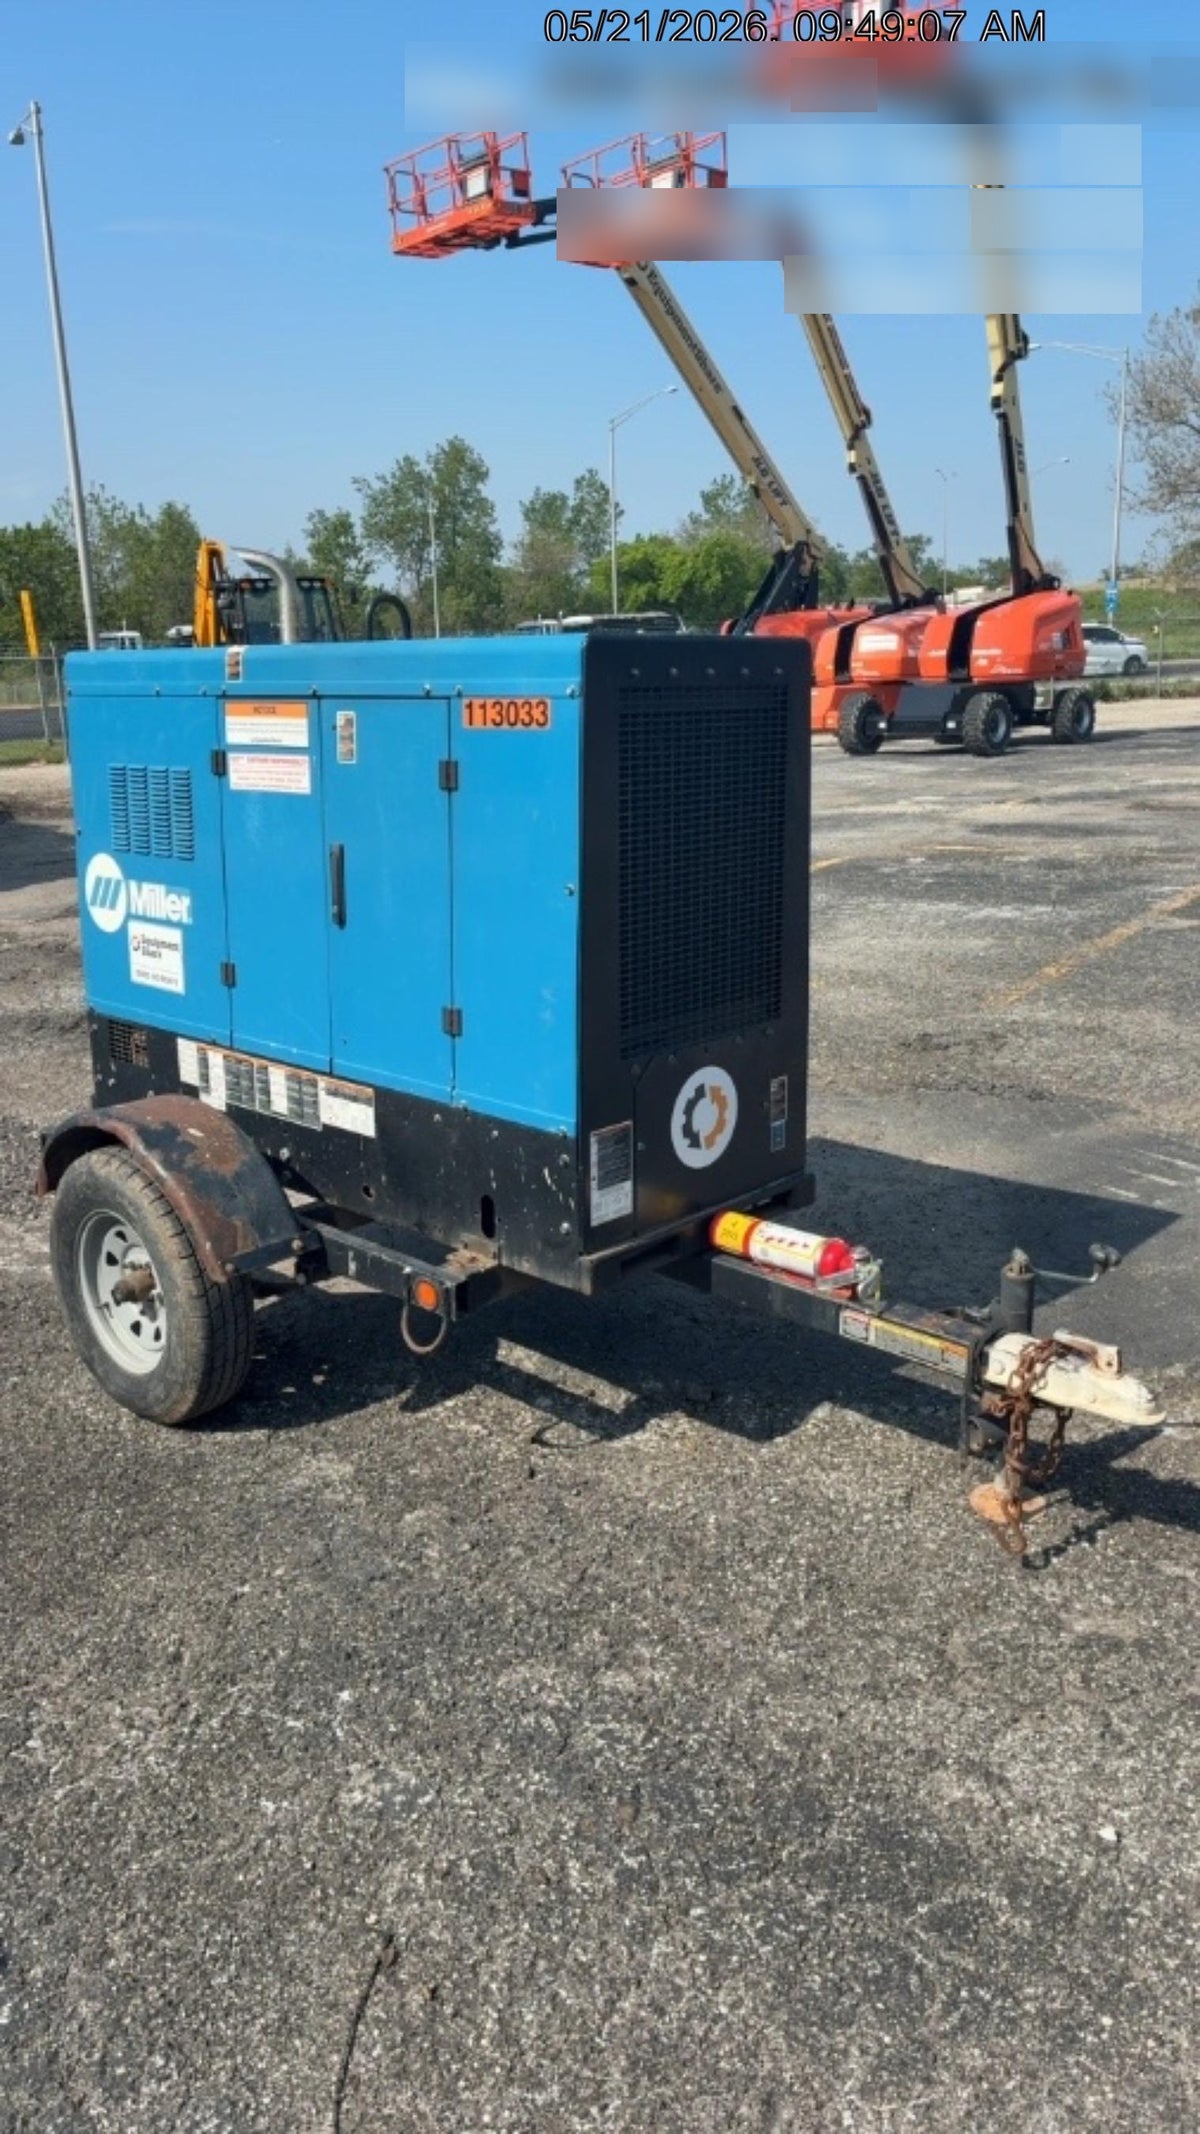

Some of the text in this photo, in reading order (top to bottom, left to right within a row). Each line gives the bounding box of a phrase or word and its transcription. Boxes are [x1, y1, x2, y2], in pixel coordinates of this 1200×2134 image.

[751, 455, 793, 507] JLG LIFT
[464, 700, 549, 727] 113033
[127, 879, 191, 925] Miller
